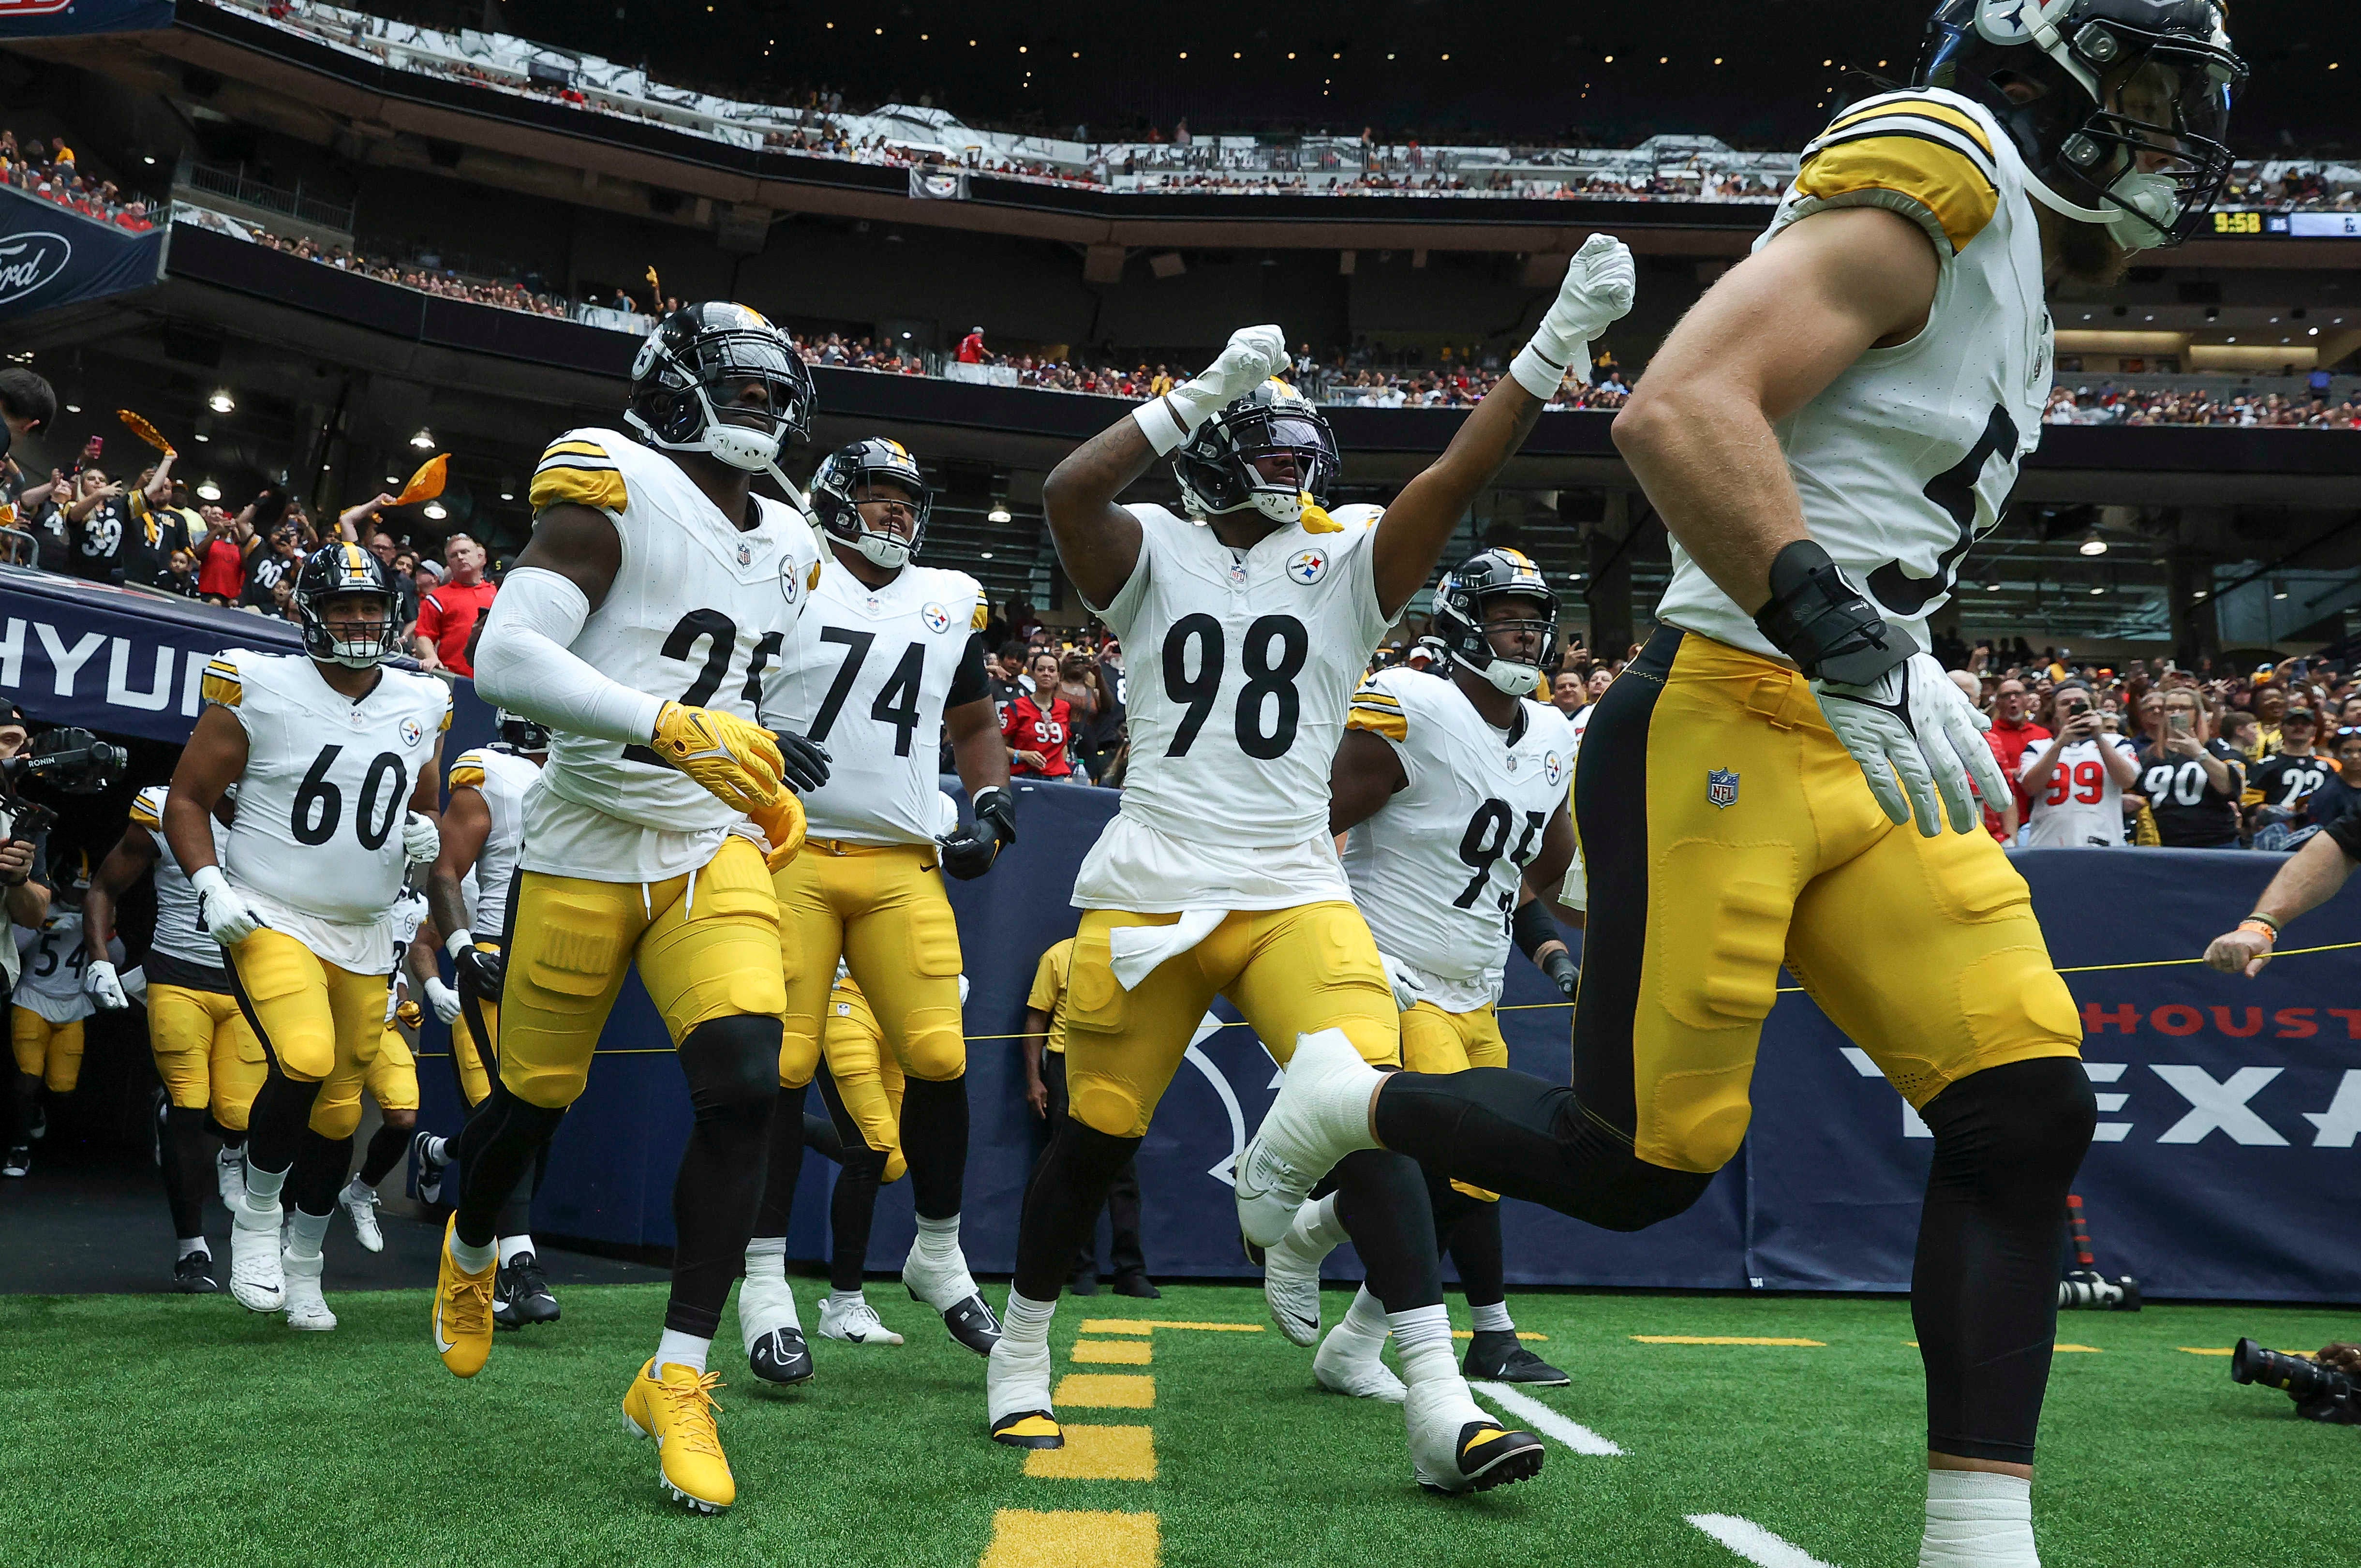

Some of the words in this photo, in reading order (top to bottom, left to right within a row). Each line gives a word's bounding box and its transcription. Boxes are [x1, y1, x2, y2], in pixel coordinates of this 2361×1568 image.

[2214, 212, 2261, 233] 9:58
[82, 518, 121, 557] 39
[254, 559, 282, 589] 90
[1232, 571, 1243, 580] NFL
[807, 626, 925, 757] 74
[1162, 613, 1308, 760] 98
[1035, 722, 1063, 743] 99
[28, 756, 55, 768] RONIN
[291, 744, 407, 851] 60
[1713, 785, 1734, 800] NFL
[2046, 761, 2103, 805] 99
[2144, 761, 2209, 809] 90
[35, 933, 88, 978] 54
